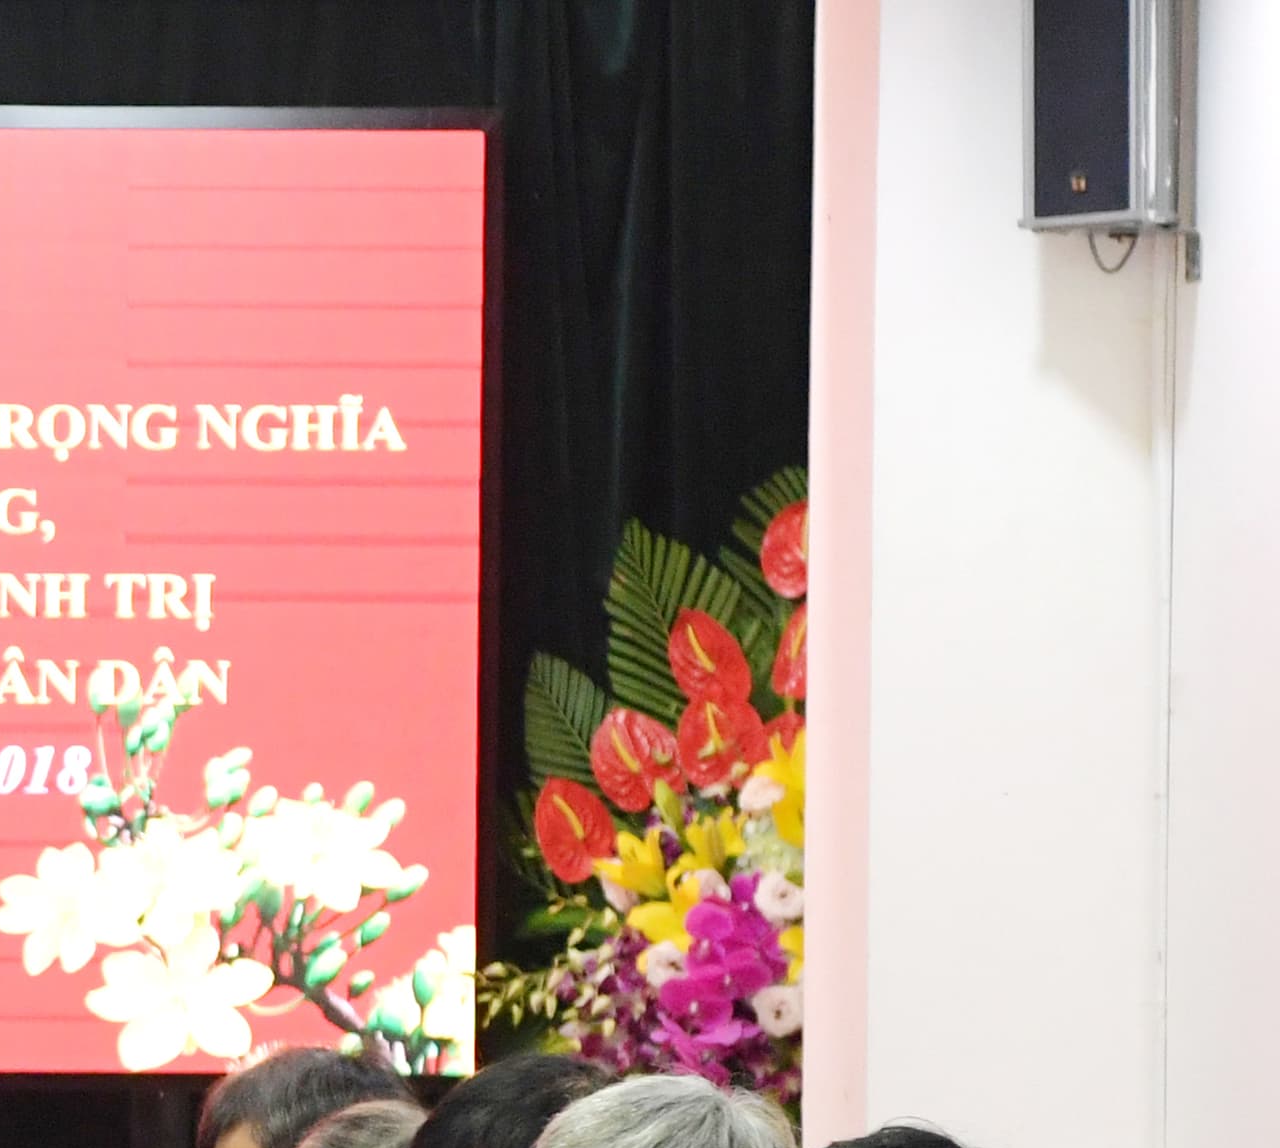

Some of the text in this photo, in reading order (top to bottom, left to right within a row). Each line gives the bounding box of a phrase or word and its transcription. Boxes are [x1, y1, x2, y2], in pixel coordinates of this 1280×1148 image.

[195, 394, 407, 451] NGHĨA
[104, 573, 217, 632] TRỊ
[95, 646, 231, 705] DÂN
